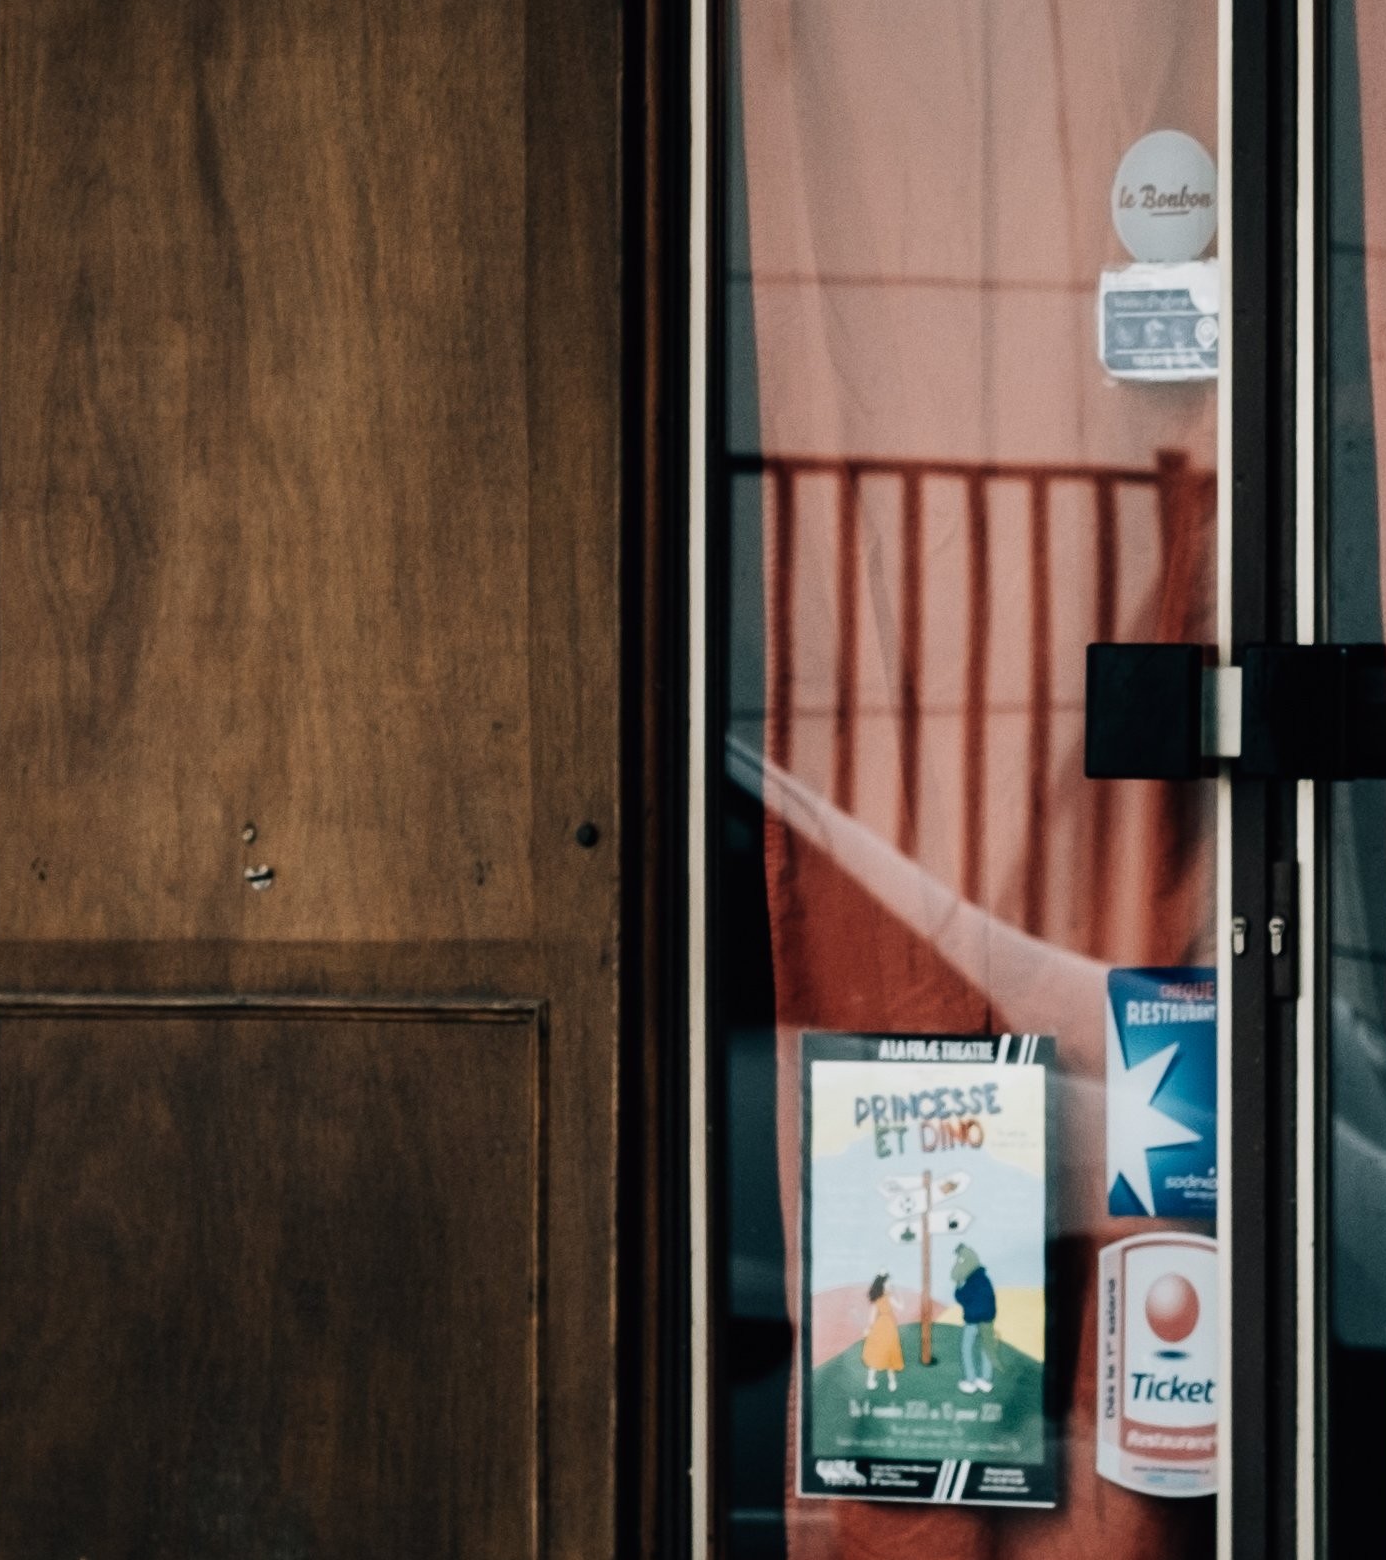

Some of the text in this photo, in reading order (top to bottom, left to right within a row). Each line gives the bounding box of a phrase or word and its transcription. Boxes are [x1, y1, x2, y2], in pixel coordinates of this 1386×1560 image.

[1139, 183, 1213, 210] Bonbon
[854, 1082, 1002, 1127] PRINCESSE
[874, 1122, 909, 1160] ET
[919, 1118, 985, 1153] DINO
[1130, 1373, 1216, 1405] Ticket
